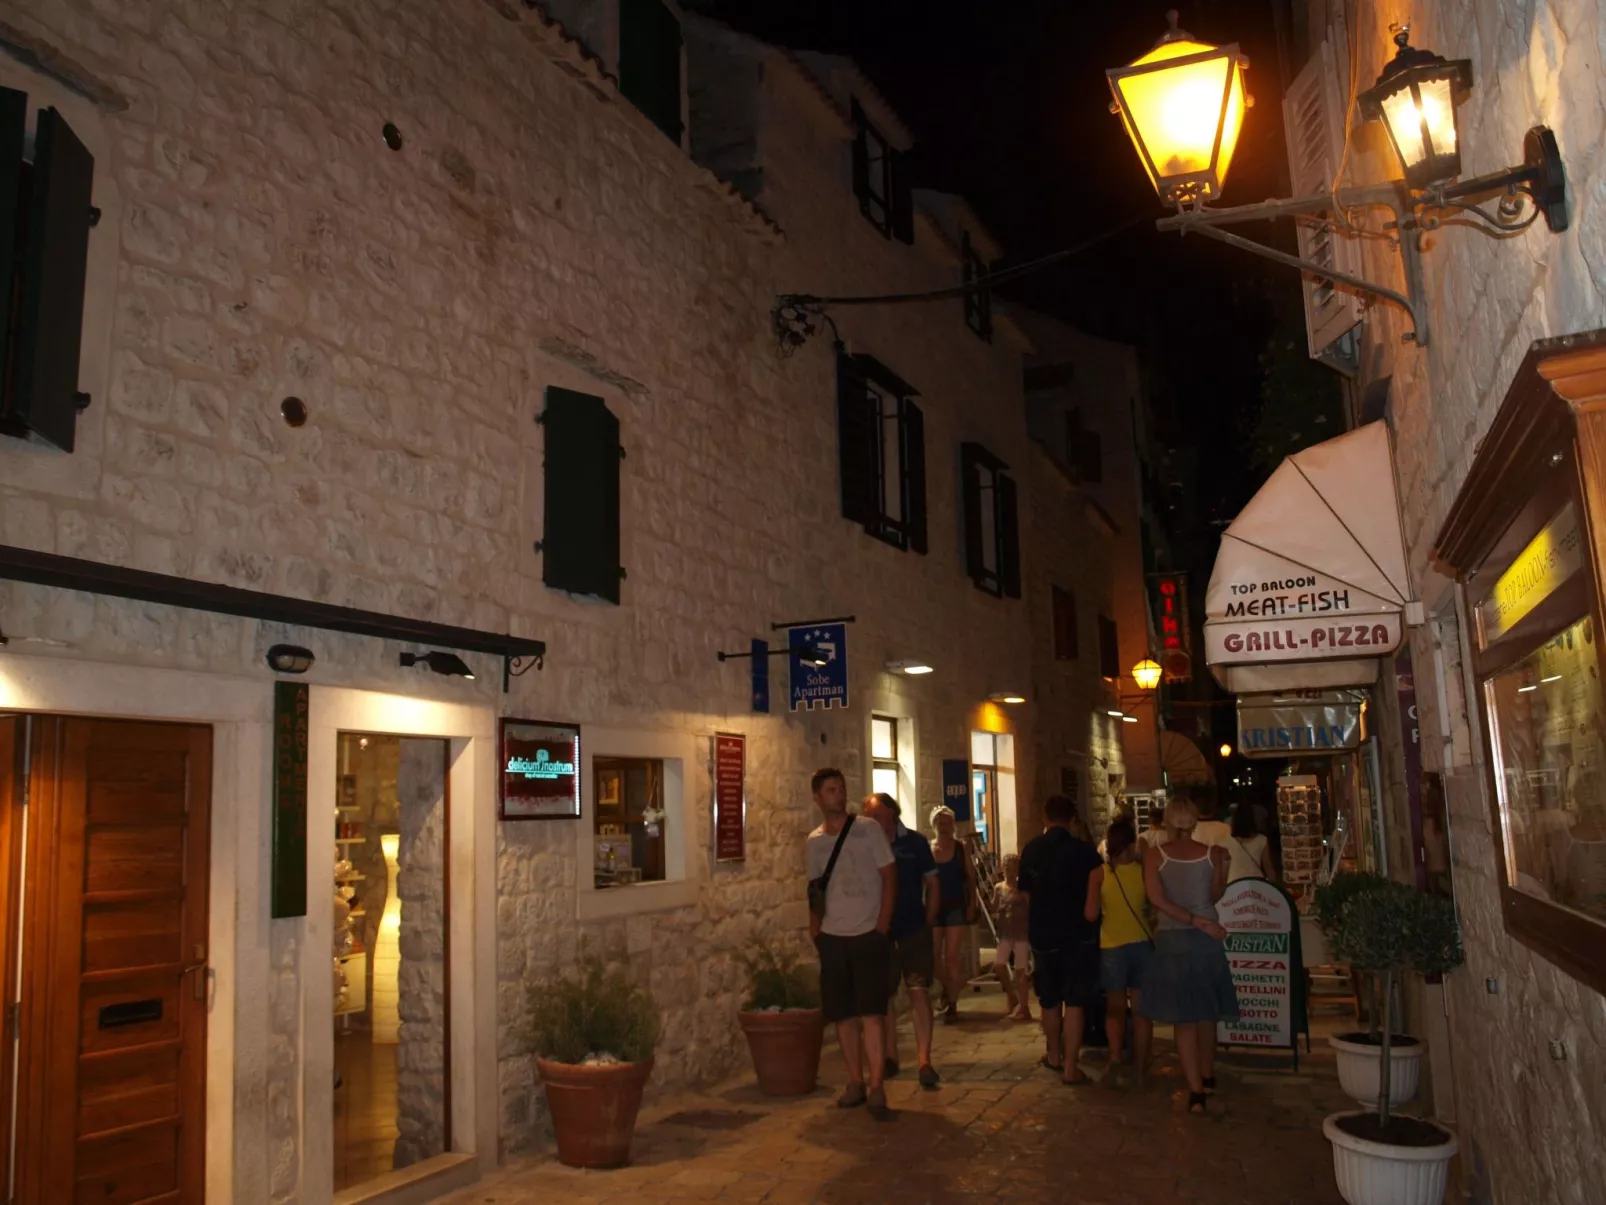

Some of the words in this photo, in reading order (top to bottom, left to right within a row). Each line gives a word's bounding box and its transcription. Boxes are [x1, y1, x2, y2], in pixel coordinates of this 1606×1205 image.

[1231, 583, 1257, 596] TOP
[1261, 576, 1316, 592] BALOON
[1224, 590, 1350, 618] MEAT-FISH
[1223, 624, 1389, 653] GRILL-PIZZA
[806, 674, 830, 686] Sobe
[793, 685, 844, 700] Apartman
[1228, 960, 1287, 970] IZZA
[1231, 974, 1285, 984] AGHETTI
[1235, 985, 1286, 995] RTELLINI
[1238, 998, 1280, 1008] OCCHI
[1239, 1009, 1278, 1019] SOTTO
[1230, 1032, 1272, 1043] SALATE
